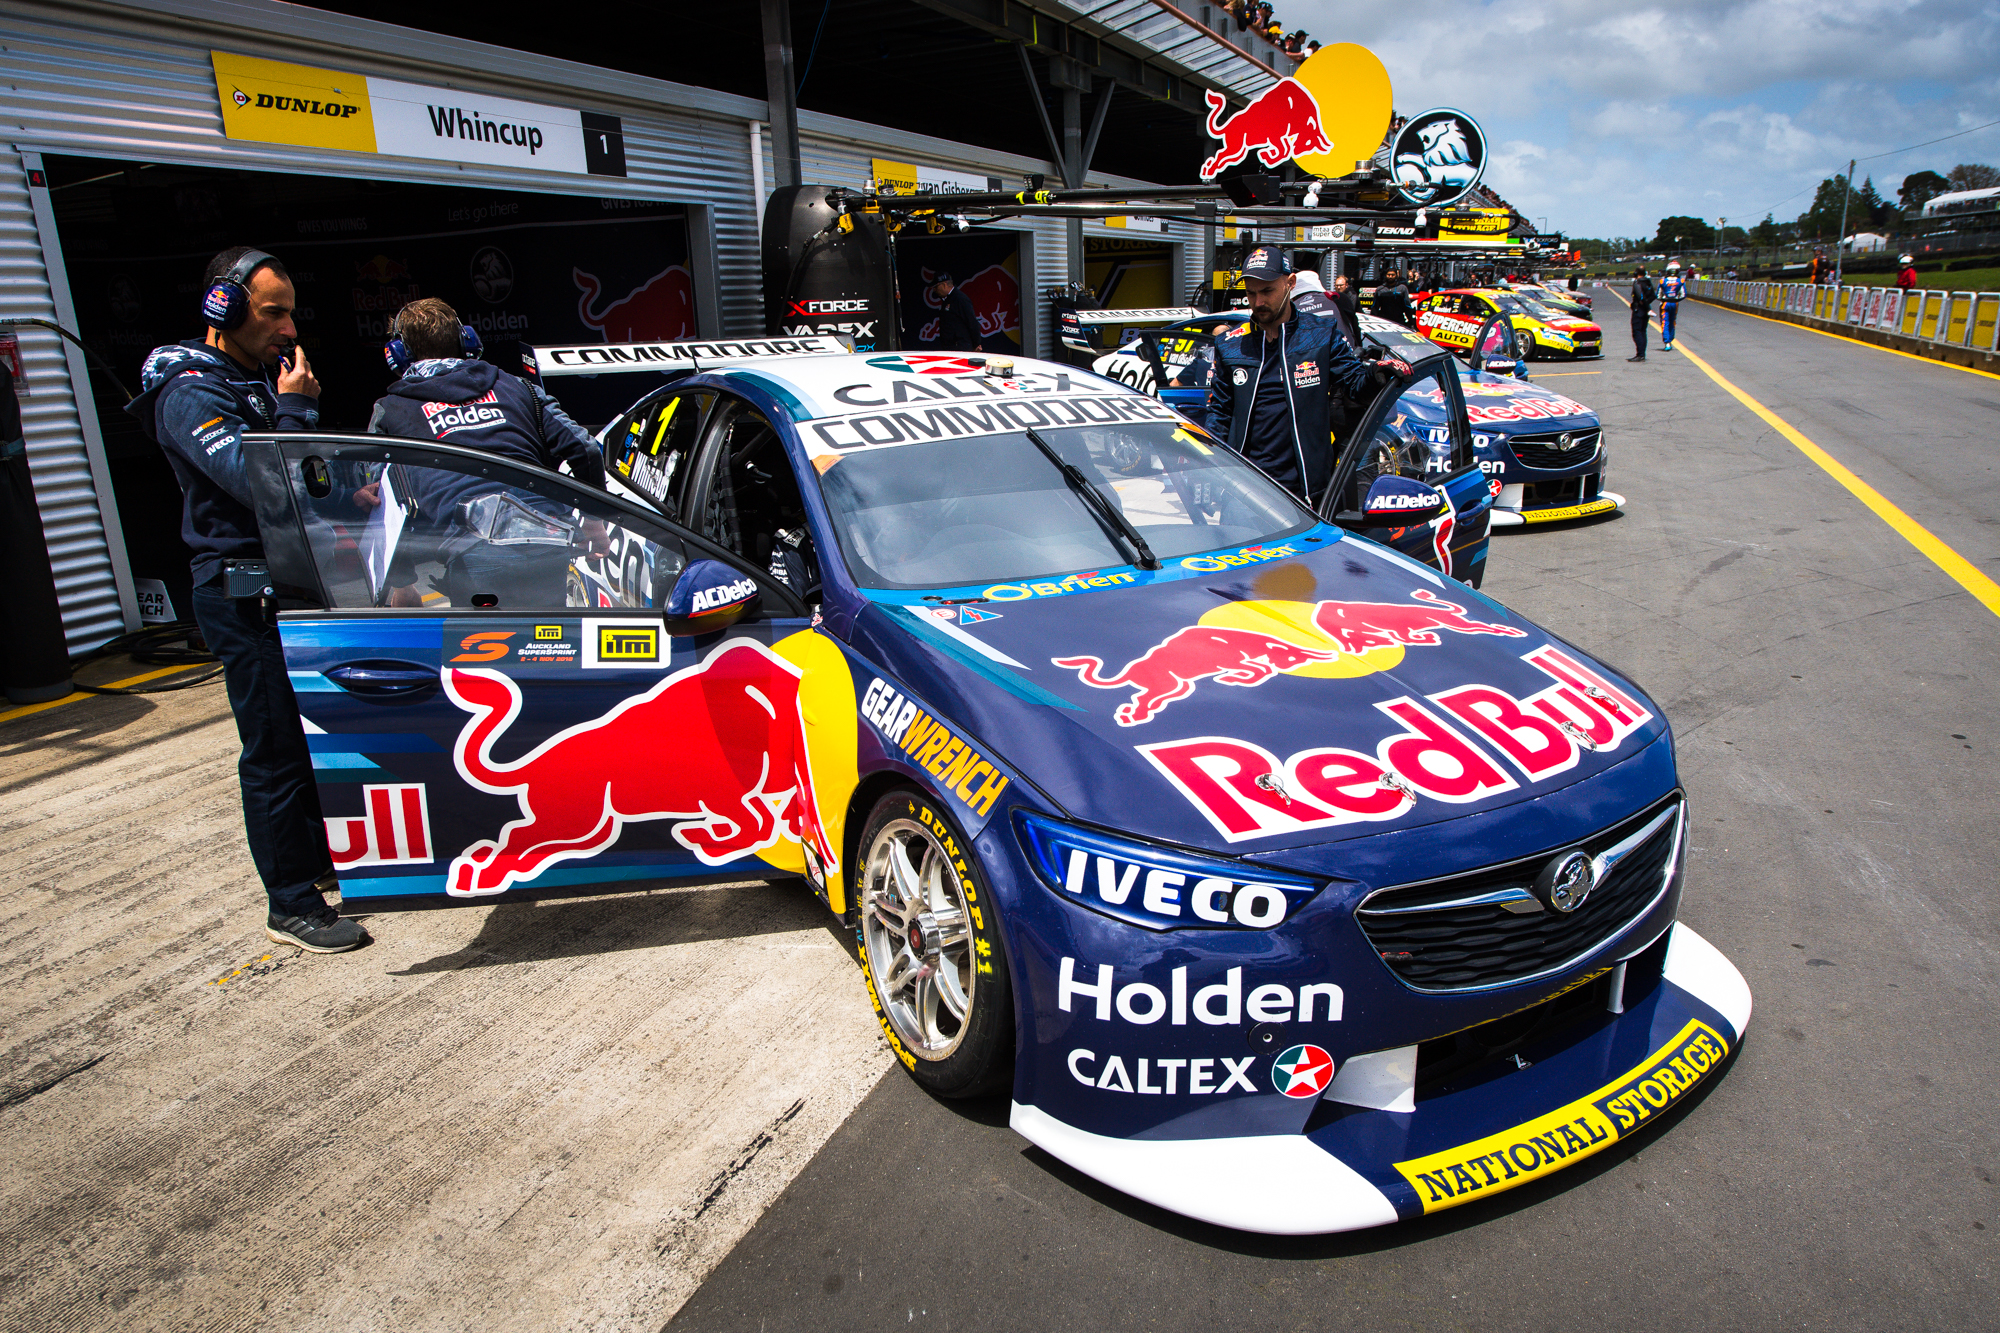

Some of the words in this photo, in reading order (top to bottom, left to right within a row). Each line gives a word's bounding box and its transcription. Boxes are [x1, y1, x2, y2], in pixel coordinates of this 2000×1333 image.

[255, 93, 358, 118] DUNLOP
[427, 105, 543, 154] Whincup
[599, 134, 609, 155] 1
[32, 171, 41, 185] 4
[884, 178, 915, 190] DUNLOP
[448, 206, 471, 223] Let's
[473, 208, 487, 223] go
[489, 202, 519, 218] there
[1376, 226, 1416, 236] TEKNO
[352, 287, 388, 312] Red
[785, 299, 870, 317] XFORCE
[1297, 302, 1323, 313] anon
[1431, 295, 1444, 307] 55
[469, 312, 529, 333] Holden
[1435, 332, 1469, 344] AUTO
[551, 339, 828, 366] COMMODORE
[1294, 369, 1307, 379] Red
[1306, 367, 1320, 377] Bull
[1295, 376, 1321, 387] Holden
[833, 373, 1101, 406] CALTEX
[428, 406, 505, 435] Holden
[812, 397, 1176, 450] COMMODORE
[1464, 398, 1552, 425] Red
[650, 396, 681, 456] 1
[206, 435, 236, 457] IVECO
[1171, 428, 1215, 456] 1
[1370, 493, 1440, 509] ACDelco
[1526, 507, 1578, 519] NATIONAL
[1578, 499, 1617, 515] STORAGE
[1180, 545, 1297, 572] O'Brien
[136, 592, 165, 605] EAR
[691, 578, 758, 613] ACDelco
[982, 570, 1135, 602] O'Brien
[861, 677, 1009, 818] GEARWRENCH
[1134, 695, 1520, 843] Red
[1424, 643, 1655, 784] Bull
[323, 782, 434, 871] ull
[919, 806, 985, 931] DUNLOP
[1064, 849, 1288, 928] IVECO
[857, 943, 882, 1013] MAXX
[1058, 957, 1345, 1026] Holden
[878, 1016, 918, 1073] SPORT
[1067, 1048, 1260, 1095] CALTEX
[1415, 1116, 1608, 1203] NATIONAL
[1607, 1033, 1723, 1130] STORAGE
